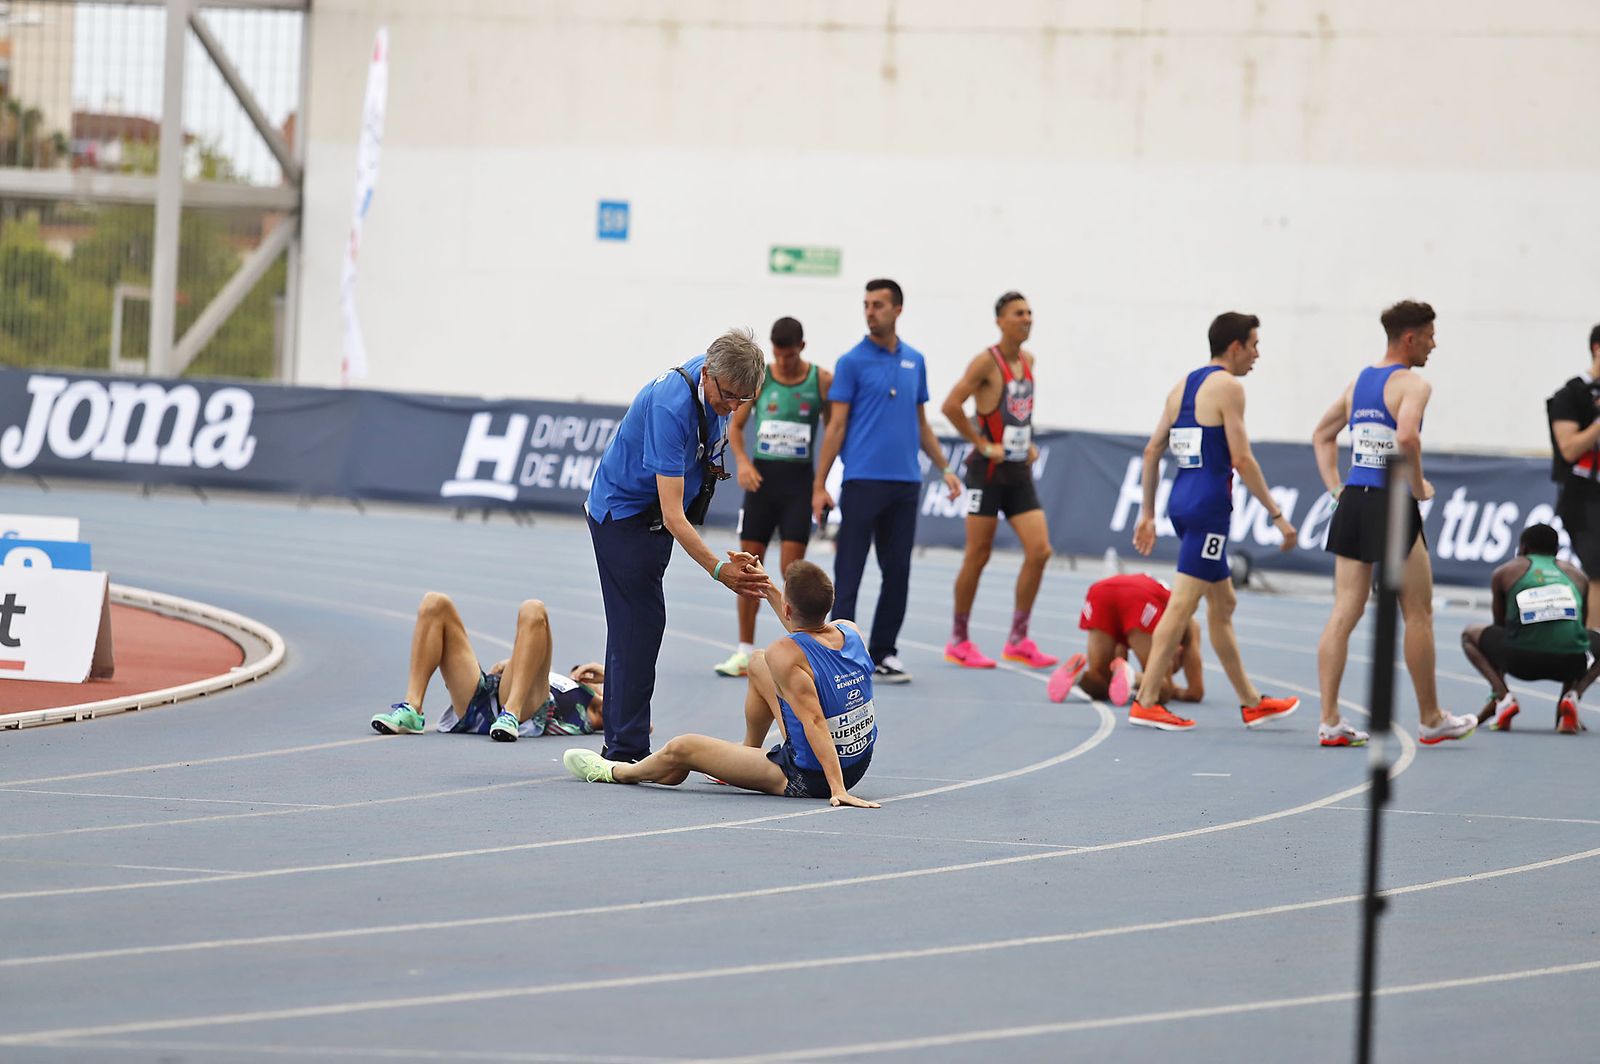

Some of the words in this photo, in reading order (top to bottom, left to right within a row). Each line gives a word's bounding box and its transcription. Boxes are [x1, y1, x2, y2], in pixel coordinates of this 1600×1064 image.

[1, 374, 257, 469] Joma
[530, 414, 622, 452] DIPUT
[1359, 439, 1394, 450] YOUNG
[519, 452, 560, 488] DE
[558, 454, 602, 491] HU
[1436, 486, 1519, 563] tus
[1206, 537, 1219, 556] 8
[853, 732, 861, 741] 32
